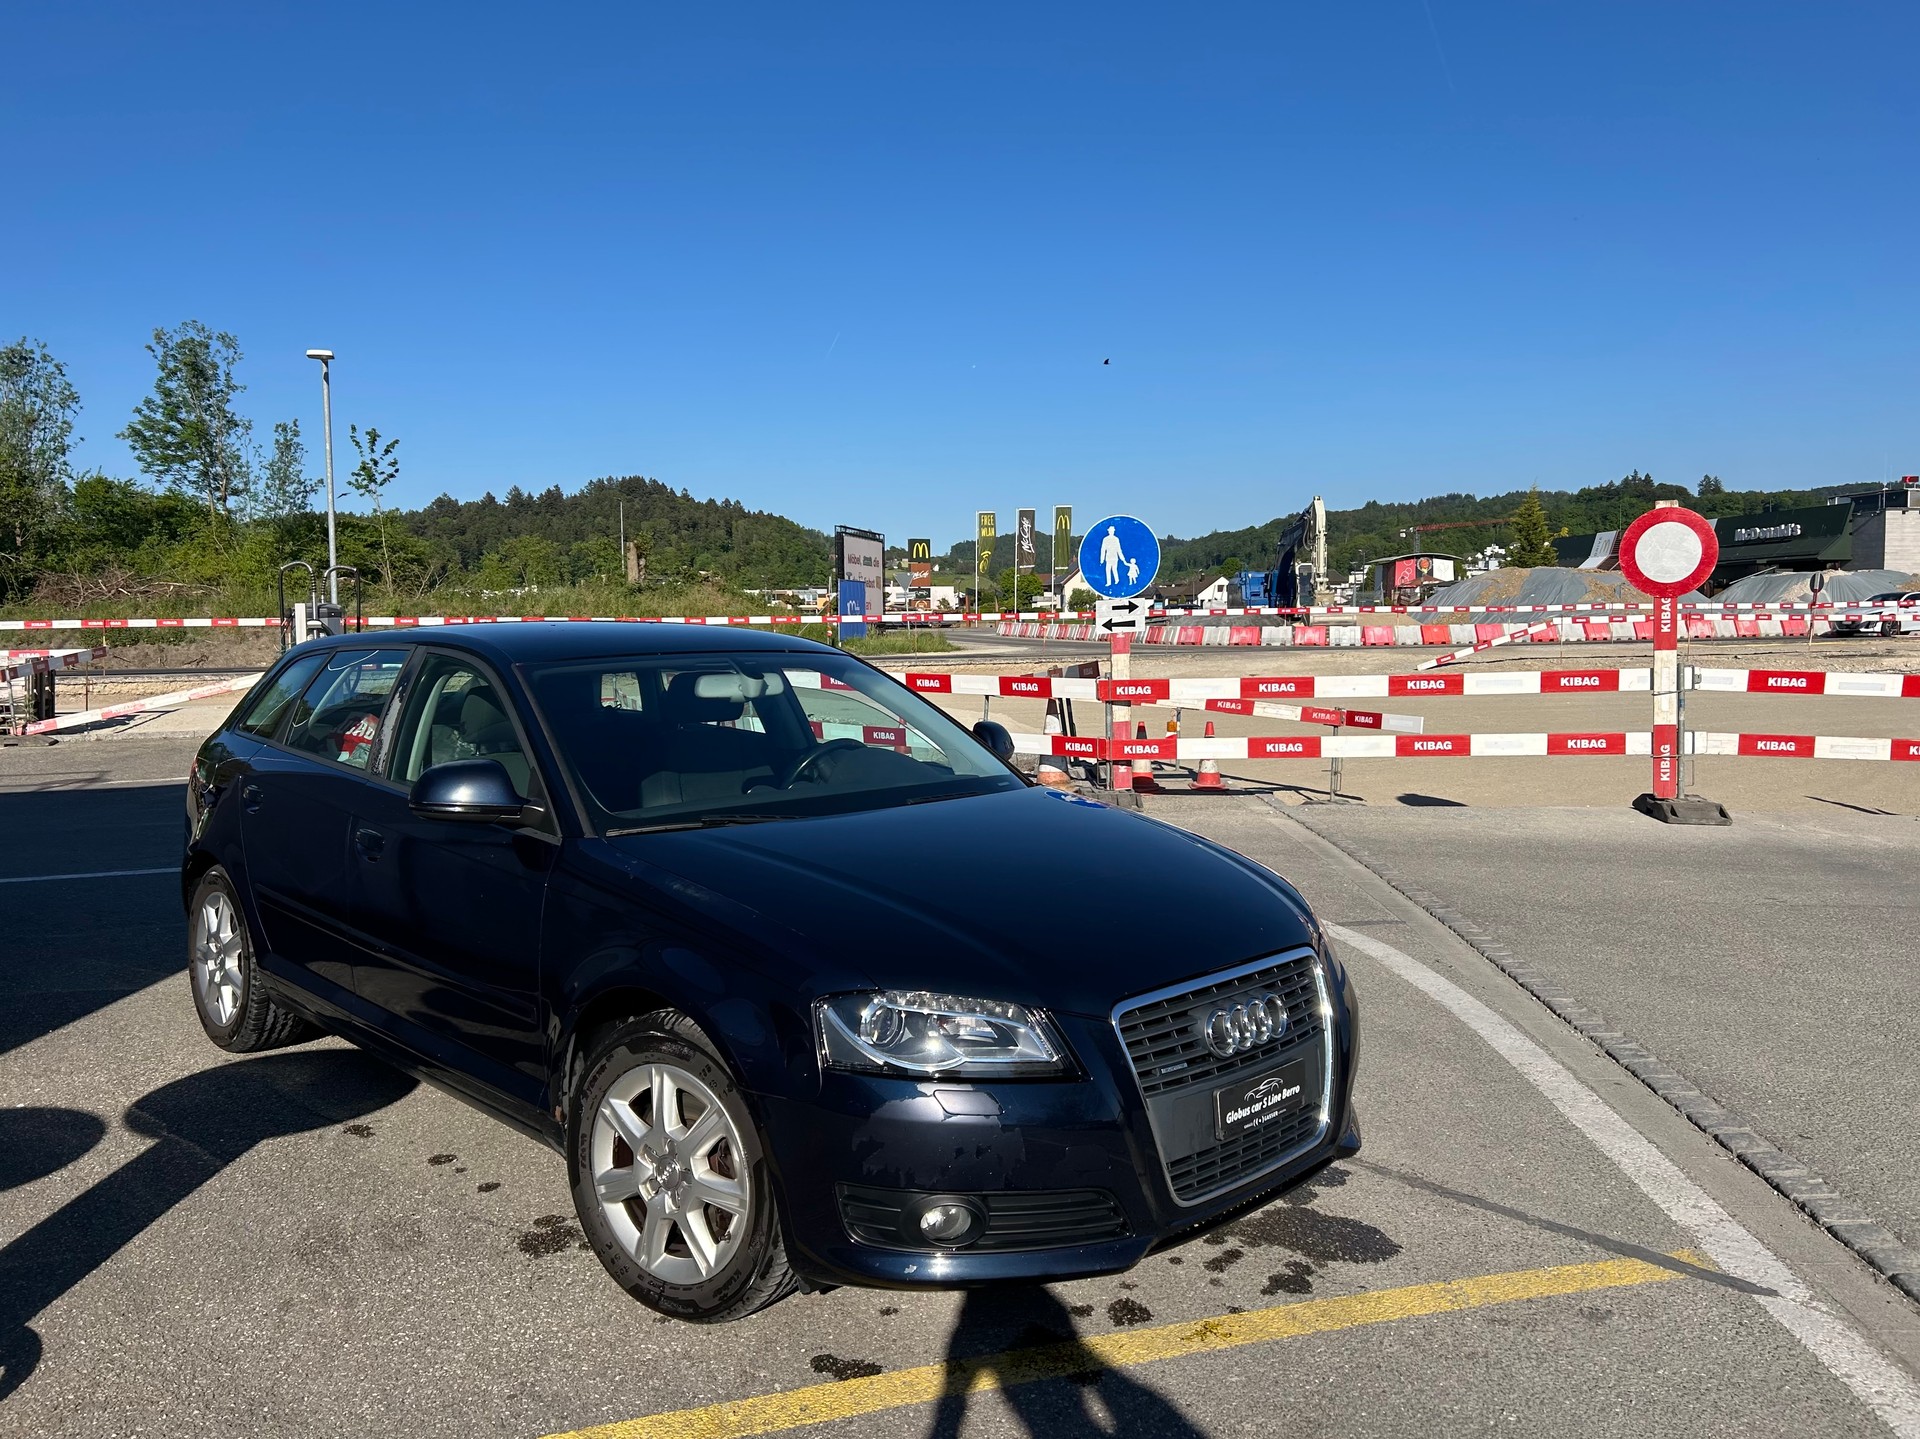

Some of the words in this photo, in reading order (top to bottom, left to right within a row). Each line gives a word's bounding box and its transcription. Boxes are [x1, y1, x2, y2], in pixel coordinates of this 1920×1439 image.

[981, 515, 994, 525] FREE
[981, 527, 995, 537] WLAN
[1734, 523, 1802, 541] McDonald's
[916, 679, 940, 688] KIBAG
[1407, 680, 1445, 690] KIBAG
[1560, 676, 1600, 687] KIBAG
[1768, 677, 1807, 688] KIBAG
[1012, 682, 1039, 692] KIBAG
[1116, 686, 1152, 695] KIBAG
[1259, 683, 1295, 693] KIBAG
[1216, 700, 1242, 710] KIBAG
[1354, 715, 1374, 724] KIBAG
[873, 731, 896, 740] KIBAG
[1065, 742, 1093, 752] KIBAG
[1266, 743, 1303, 753] KIBAG
[1414, 740, 1452, 751] KIBAG
[1567, 738, 1607, 749] KIBAG
[1757, 740, 1796, 751] KIBAG
[1123, 745, 1159, 754] KIBAG
[1660, 744, 1671, 781] KIBAG
[1226, 1106, 1251, 1124] Globus
[1251, 1101, 1263, 1113] car
[1262, 1097, 1268, 1109] S
[1267, 1093, 1282, 1106] Line
[1281, 1085, 1301, 1100] Berro
